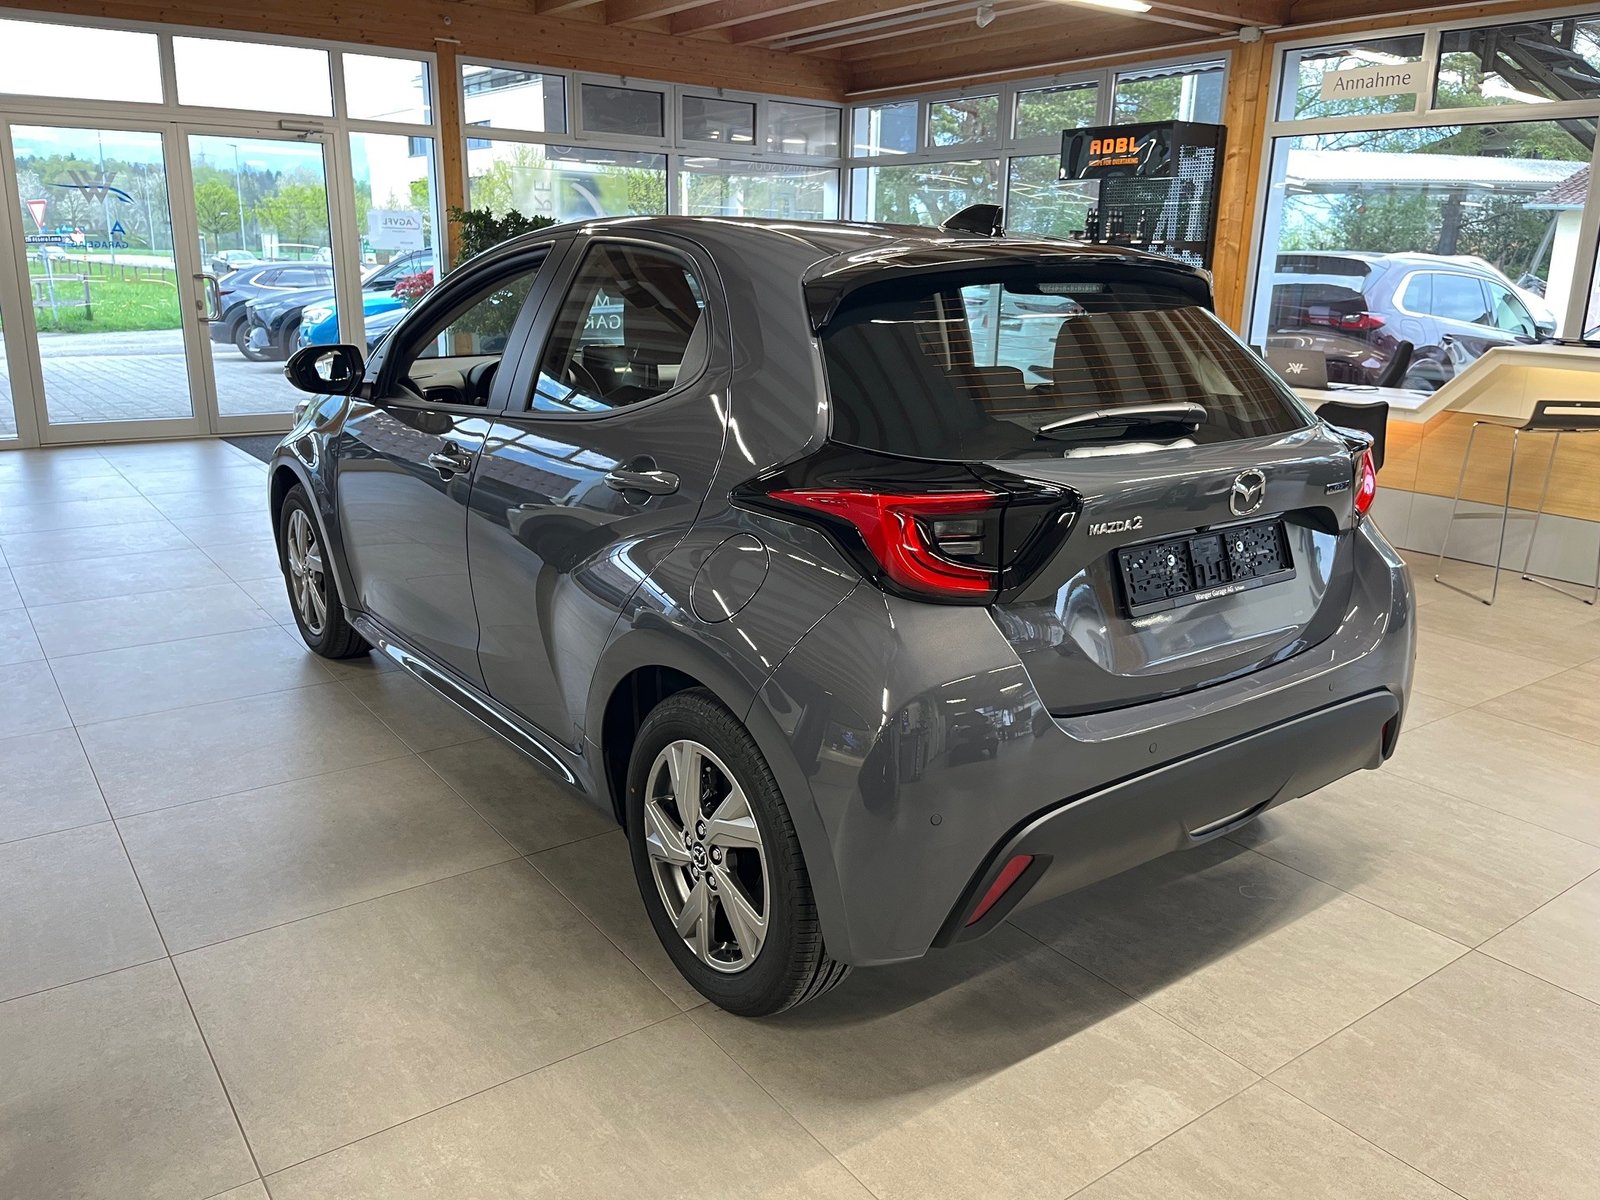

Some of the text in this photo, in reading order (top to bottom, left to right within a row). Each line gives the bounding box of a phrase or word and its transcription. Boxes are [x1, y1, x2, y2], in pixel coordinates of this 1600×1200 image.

[1333, 72, 1411, 91] Annahme
[1089, 136, 1139, 155] ADBL
[1195, 592, 1211, 600] Wanger
